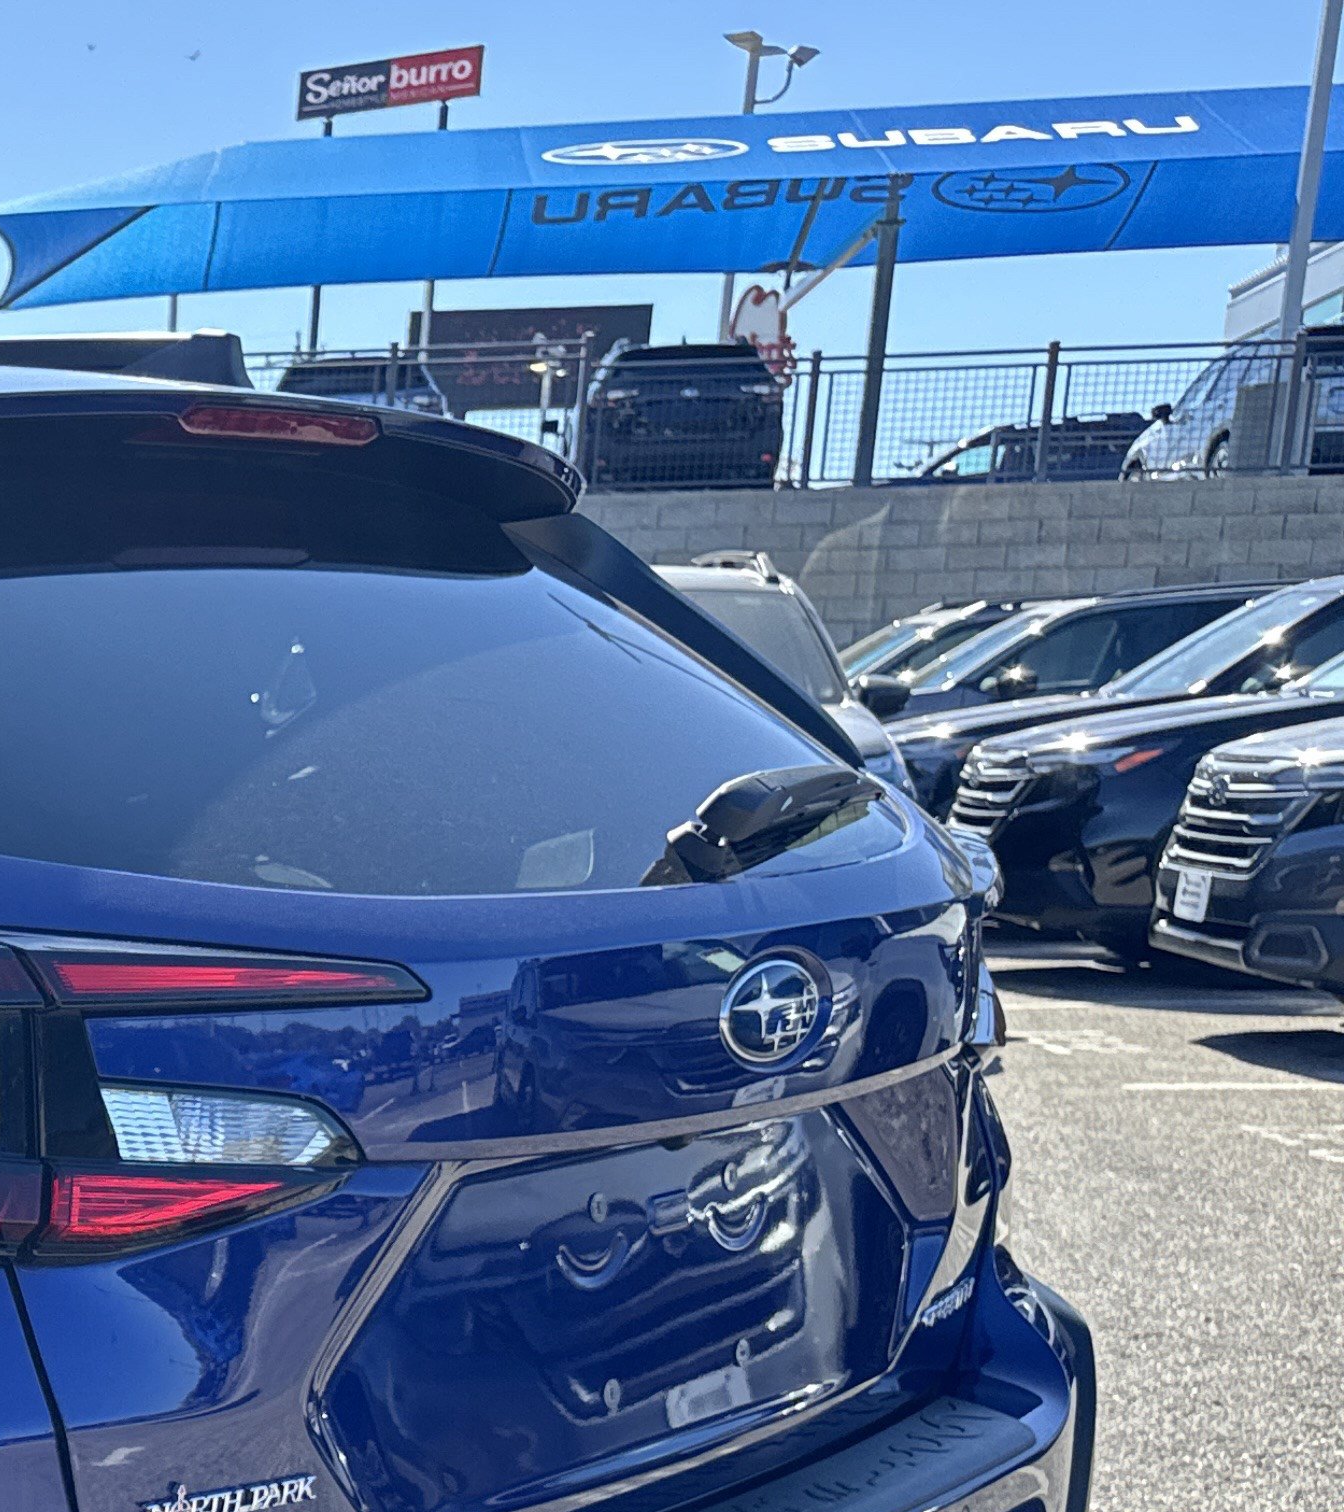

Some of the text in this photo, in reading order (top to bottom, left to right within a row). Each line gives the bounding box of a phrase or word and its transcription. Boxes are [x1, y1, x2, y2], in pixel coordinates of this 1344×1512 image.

[305, 72, 386, 104] Señor
[390, 59, 473, 89] burro
[767, 115, 1200, 153] SUBARU
